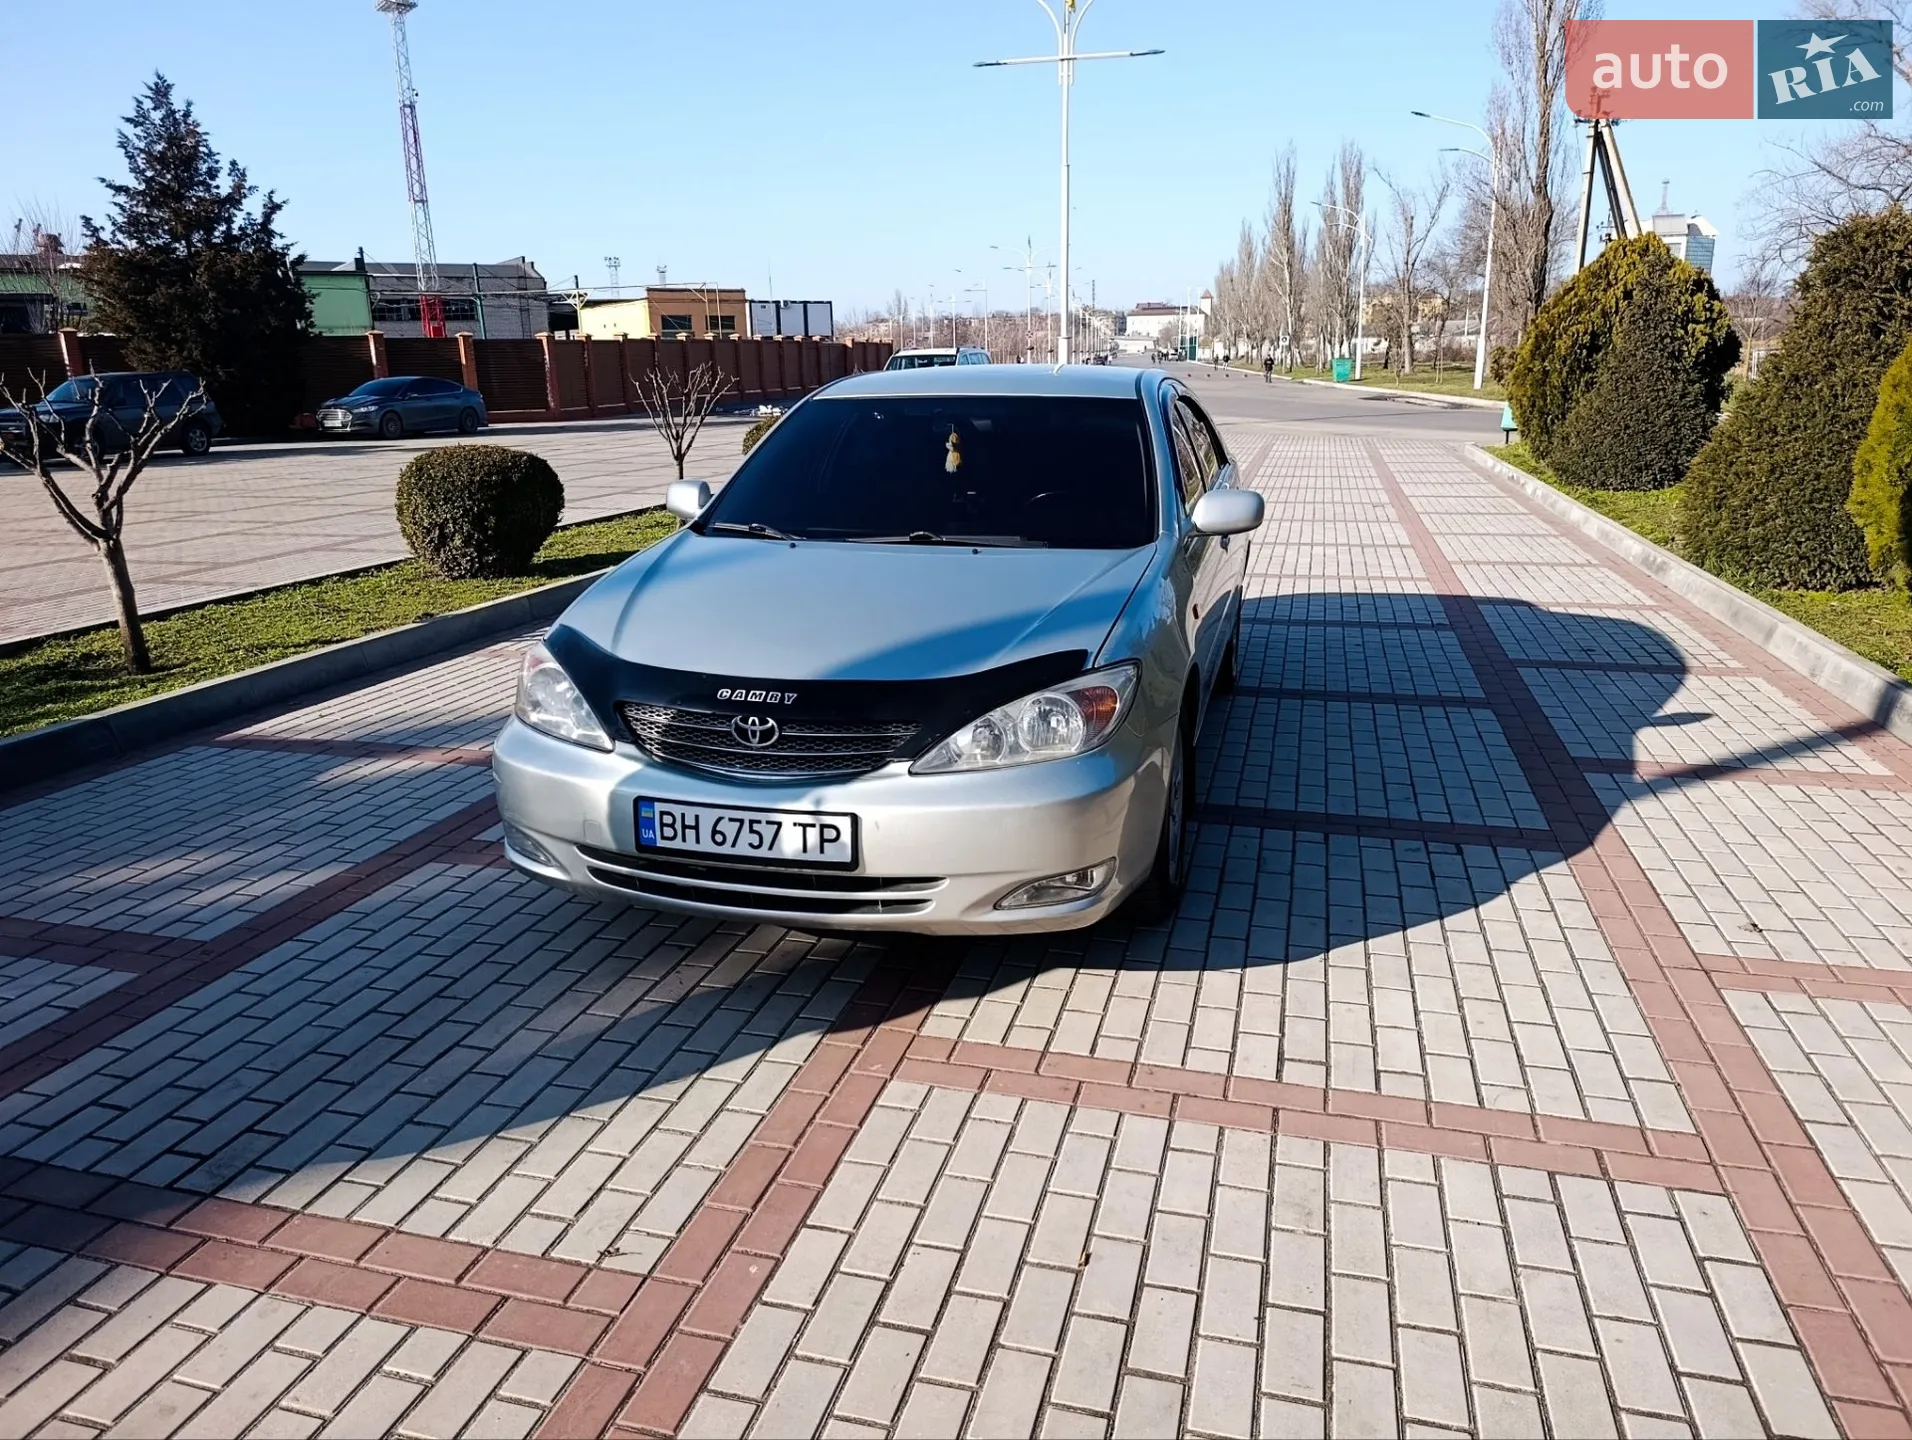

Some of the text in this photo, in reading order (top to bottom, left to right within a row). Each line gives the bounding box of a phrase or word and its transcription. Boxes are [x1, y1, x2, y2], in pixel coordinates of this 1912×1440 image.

[717, 688, 797, 704] CAMRY
[641, 828, 655, 839] UA
[658, 810, 841, 854] BH 6757 TP
